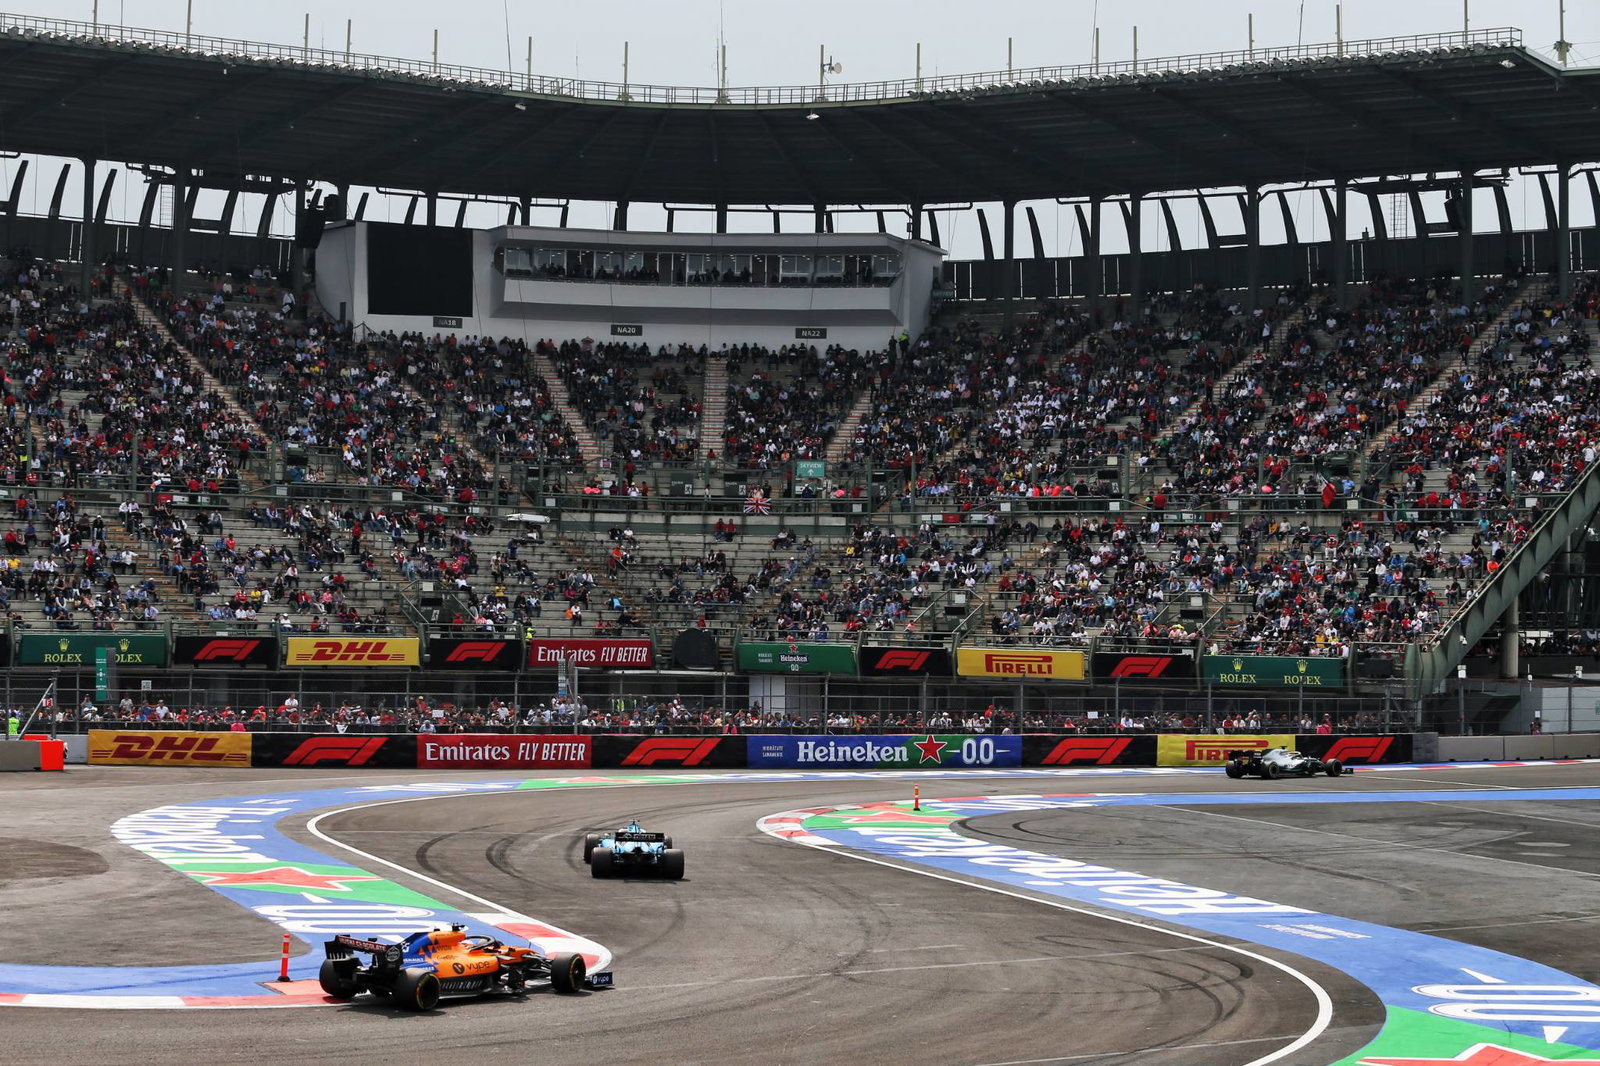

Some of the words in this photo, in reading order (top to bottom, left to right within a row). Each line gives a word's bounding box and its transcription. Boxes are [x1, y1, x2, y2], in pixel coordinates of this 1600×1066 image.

[44, 653, 83, 663] ROLEX
[310, 641, 391, 661] DHL
[601, 647, 616, 661] FLY
[617, 647, 648, 663] BETTER
[985, 654, 1053, 675] PIRELLI
[1220, 673, 1257, 684] ROLEX
[1284, 675, 1322, 685] ROLEX
[111, 735, 226, 761] DHL
[425, 742, 510, 761] Emirates
[518, 743, 539, 761] FLY
[541, 743, 586, 761] BETTER
[797, 741, 909, 762] Heineken
[110, 805, 292, 866] Heineken
[854, 827, 1321, 915] Heineken
[466, 961, 490, 974] vype
